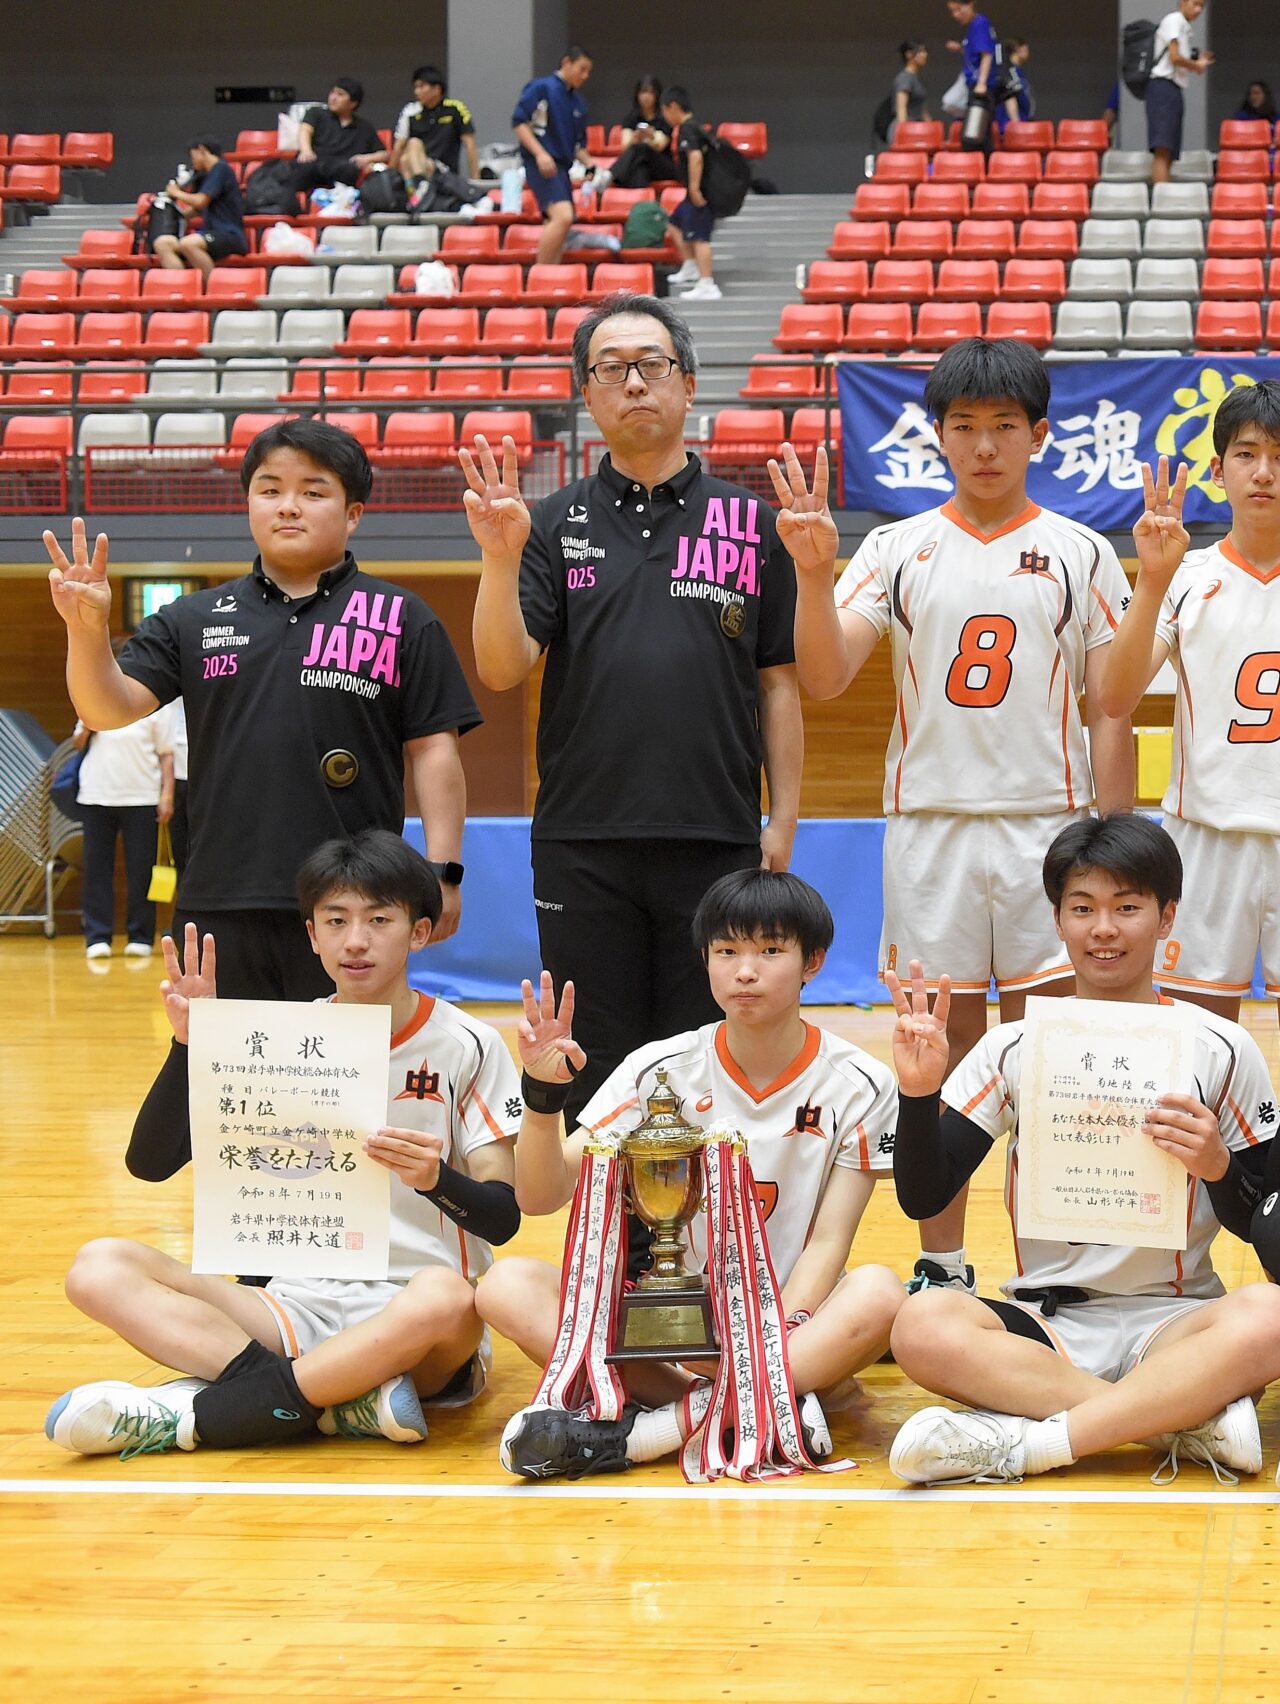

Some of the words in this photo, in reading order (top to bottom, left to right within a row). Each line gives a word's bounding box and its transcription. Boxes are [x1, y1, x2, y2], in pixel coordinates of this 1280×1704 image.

[702, 497, 761, 544] ALL
[567, 565, 596, 590] 025
[340, 590, 404, 636] ALL
[202, 626, 235, 638] SUMMER
[202, 635, 250, 650] COMPETITION
[203, 653, 238, 680] 2025
[302, 623, 400, 688] JAPA
[945, 614, 1017, 708] 8
[300, 668, 381, 700] CHAMPIONSHIP
[326, 752, 354, 783] C
[887, 943, 898, 971] 8
[1163, 940, 1182, 970] 9
[245, 1030, 326, 1059] 賞状
[211, 1061, 360, 1079] 第73回岩手県中学校総合体育大会
[1080, 1051, 1130, 1072] 賞状
[219, 1097, 277, 1117] 第1位
[505, 1097, 523, 1118] 岩
[1258, 1101, 1276, 1124] 岩
[1052, 1113, 1149, 1128] あなたを本大会優秀
[1053, 1131, 1121, 1144] として表彰します
[219, 1144, 357, 1172] 栄誉をたたえる
[239, 1186, 343, 1201] 令和8年7月19日
[230, 1212, 345, 1228] 岩手県中学校体育連盟
[234, 1231, 260, 1243] 会長
[266, 1230, 342, 1248] 照井大道
